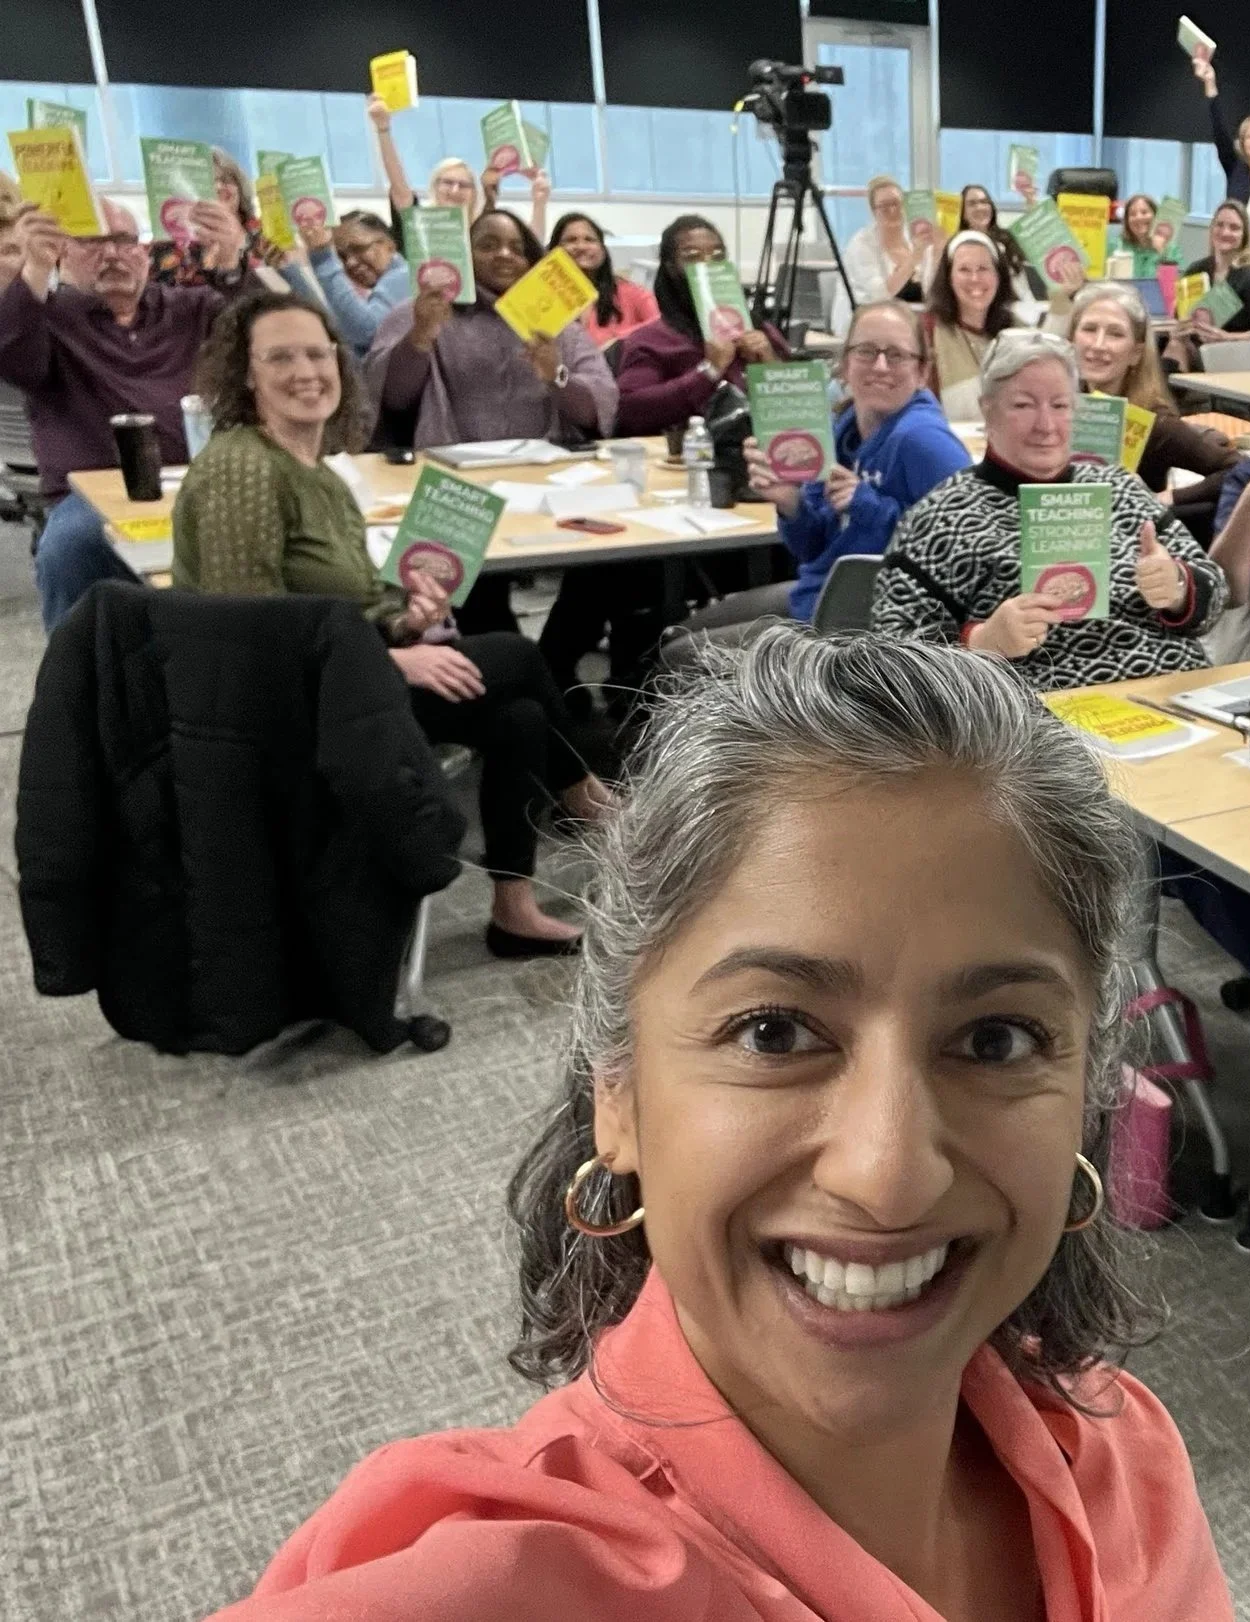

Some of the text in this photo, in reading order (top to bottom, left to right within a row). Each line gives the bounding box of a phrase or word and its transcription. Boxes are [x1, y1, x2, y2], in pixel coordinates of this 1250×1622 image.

[765, 368, 808, 381] SMART
[756, 380, 823, 395] TEACHING
[440, 478, 489, 506] SMART
[1041, 492, 1093, 507] SMART
[424, 484, 495, 524] TEACHING
[1027, 507, 1105, 522] TEACHING
[1028, 523, 1104, 539] STRONGER
[1031, 538, 1102, 553] LEARNING
